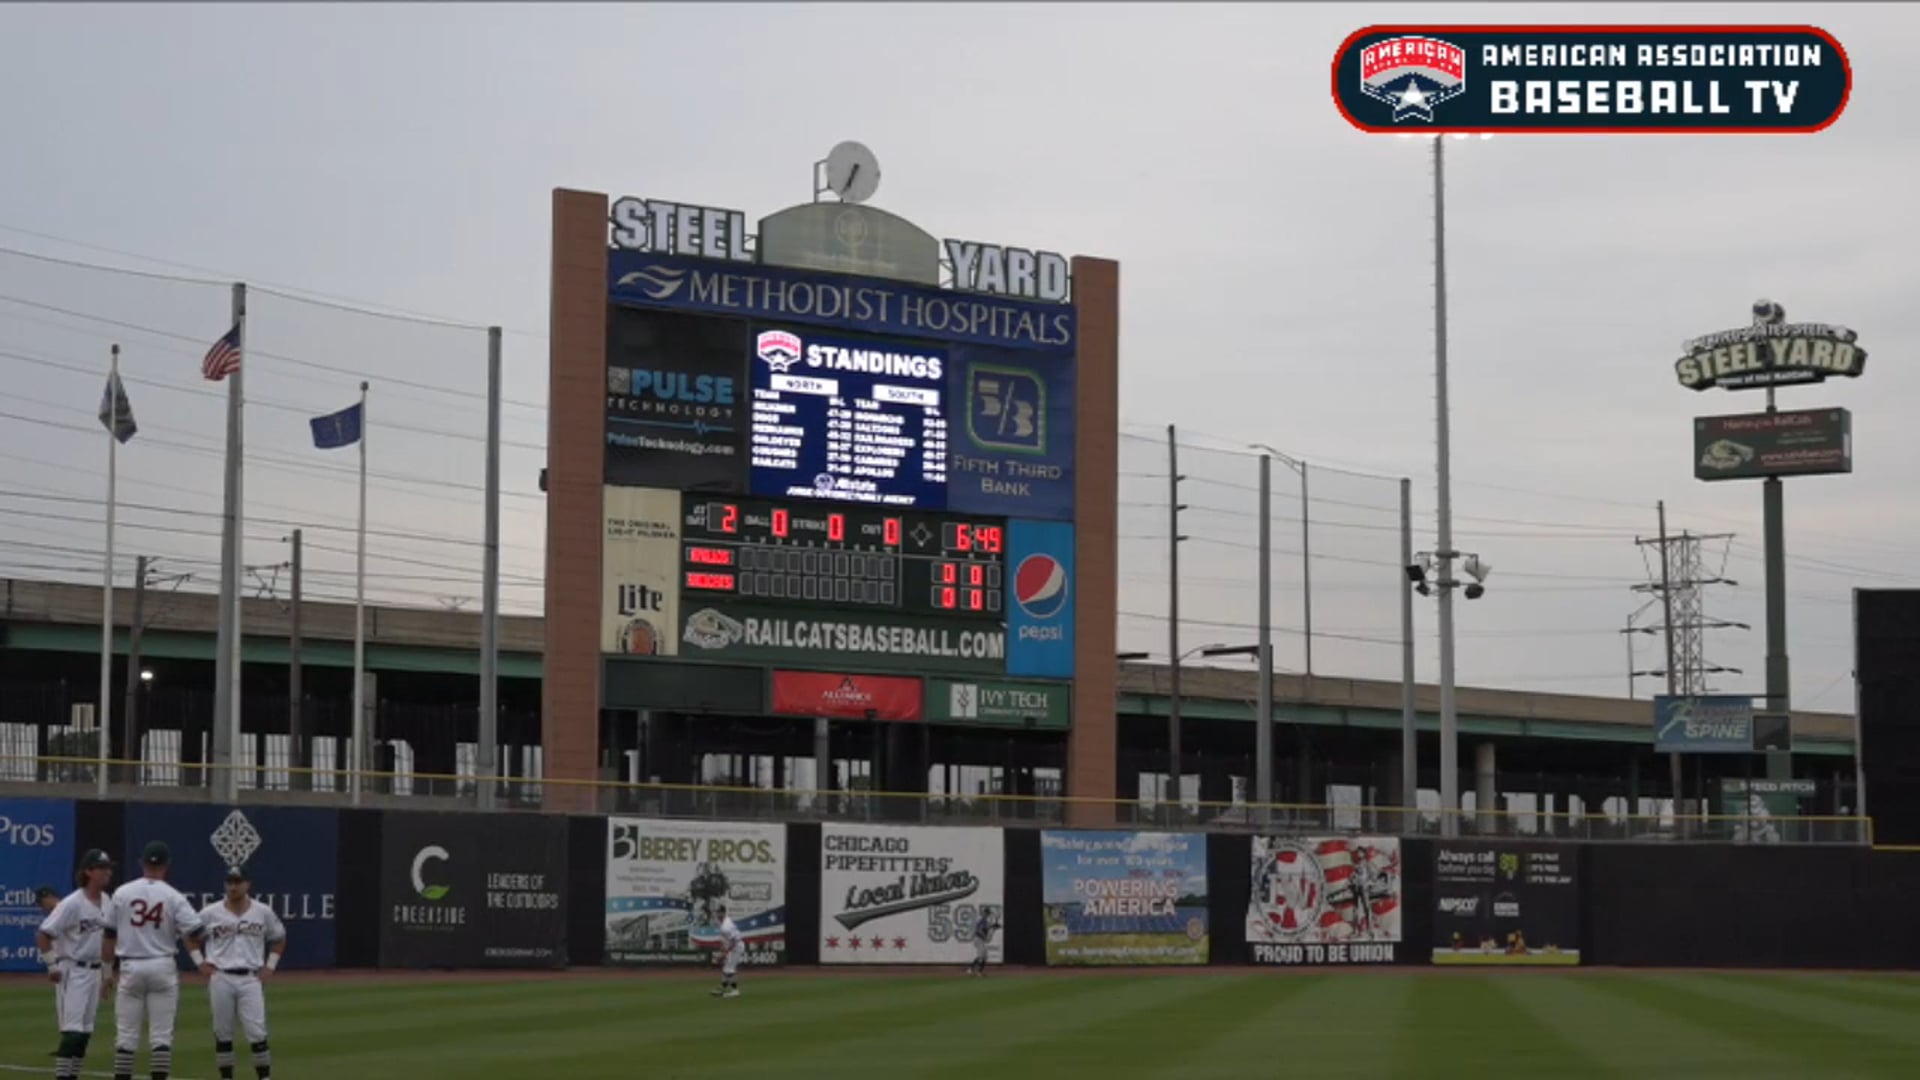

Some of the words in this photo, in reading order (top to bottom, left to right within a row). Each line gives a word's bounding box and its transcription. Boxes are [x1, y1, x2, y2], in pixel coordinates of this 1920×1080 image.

[610, 196, 756, 262] STEEL
[943, 238, 1070, 303] YARD
[689, 269, 894, 323] METHODIST
[902, 296, 1072, 346] HOSPITALS
[806, 344, 943, 380] STANDINGS
[1677, 342, 1763, 386] STEEL
[1769, 337, 1856, 371] YARD
[631, 368, 735, 404] PULSE
[786, 379, 823, 390] NORTH
[888, 386, 924, 400] SOUTH
[607, 398, 733, 419] TECHNOLOGY
[953, 455, 1000, 475] FIFTH
[1005, 460, 1062, 480] THIRD
[981, 477, 1031, 497] BANK
[721, 504, 739, 534] 2
[744, 514, 771, 527] BALL
[771, 508, 789, 538] 0
[791, 517, 828, 531] STRIKE
[827, 513, 845, 542] 0
[861, 523, 882, 536] OUT
[883, 517, 900, 546] 0
[956, 523, 1002, 553] 6:49
[617, 584, 663, 617] Lite
[744, 617, 1005, 660] RAILCATSBASEBALL.COM
[1018, 624, 1063, 642] pepsi
[980, 691, 1007, 707] IVY
[1008, 692, 1048, 708] TECH
[1684, 723, 1747, 740] SPINE
[0, 815, 55, 847] Pros
[640, 836, 701, 862] BEREY
[707, 838, 776, 864] BROS.
[824, 834, 910, 854] CHICAGO
[824, 854, 954, 874] PIPEFITTERS'
[487, 873, 529, 890] LEADERS
[531, 874, 546, 890] OF
[845, 874, 906, 910] Local
[1073, 877, 1178, 898] POWERING
[486, 891, 506, 909] THE
[506, 891, 560, 910] OUTDOORS
[1083, 898, 1178, 917] AMERICA
[129, 898, 165, 930] 34
[1253, 944, 1303, 963] PROUD
[1305, 945, 1325, 962] TO
[1328, 944, 1348, 963] BE
[1349, 944, 1395, 962] UNION
